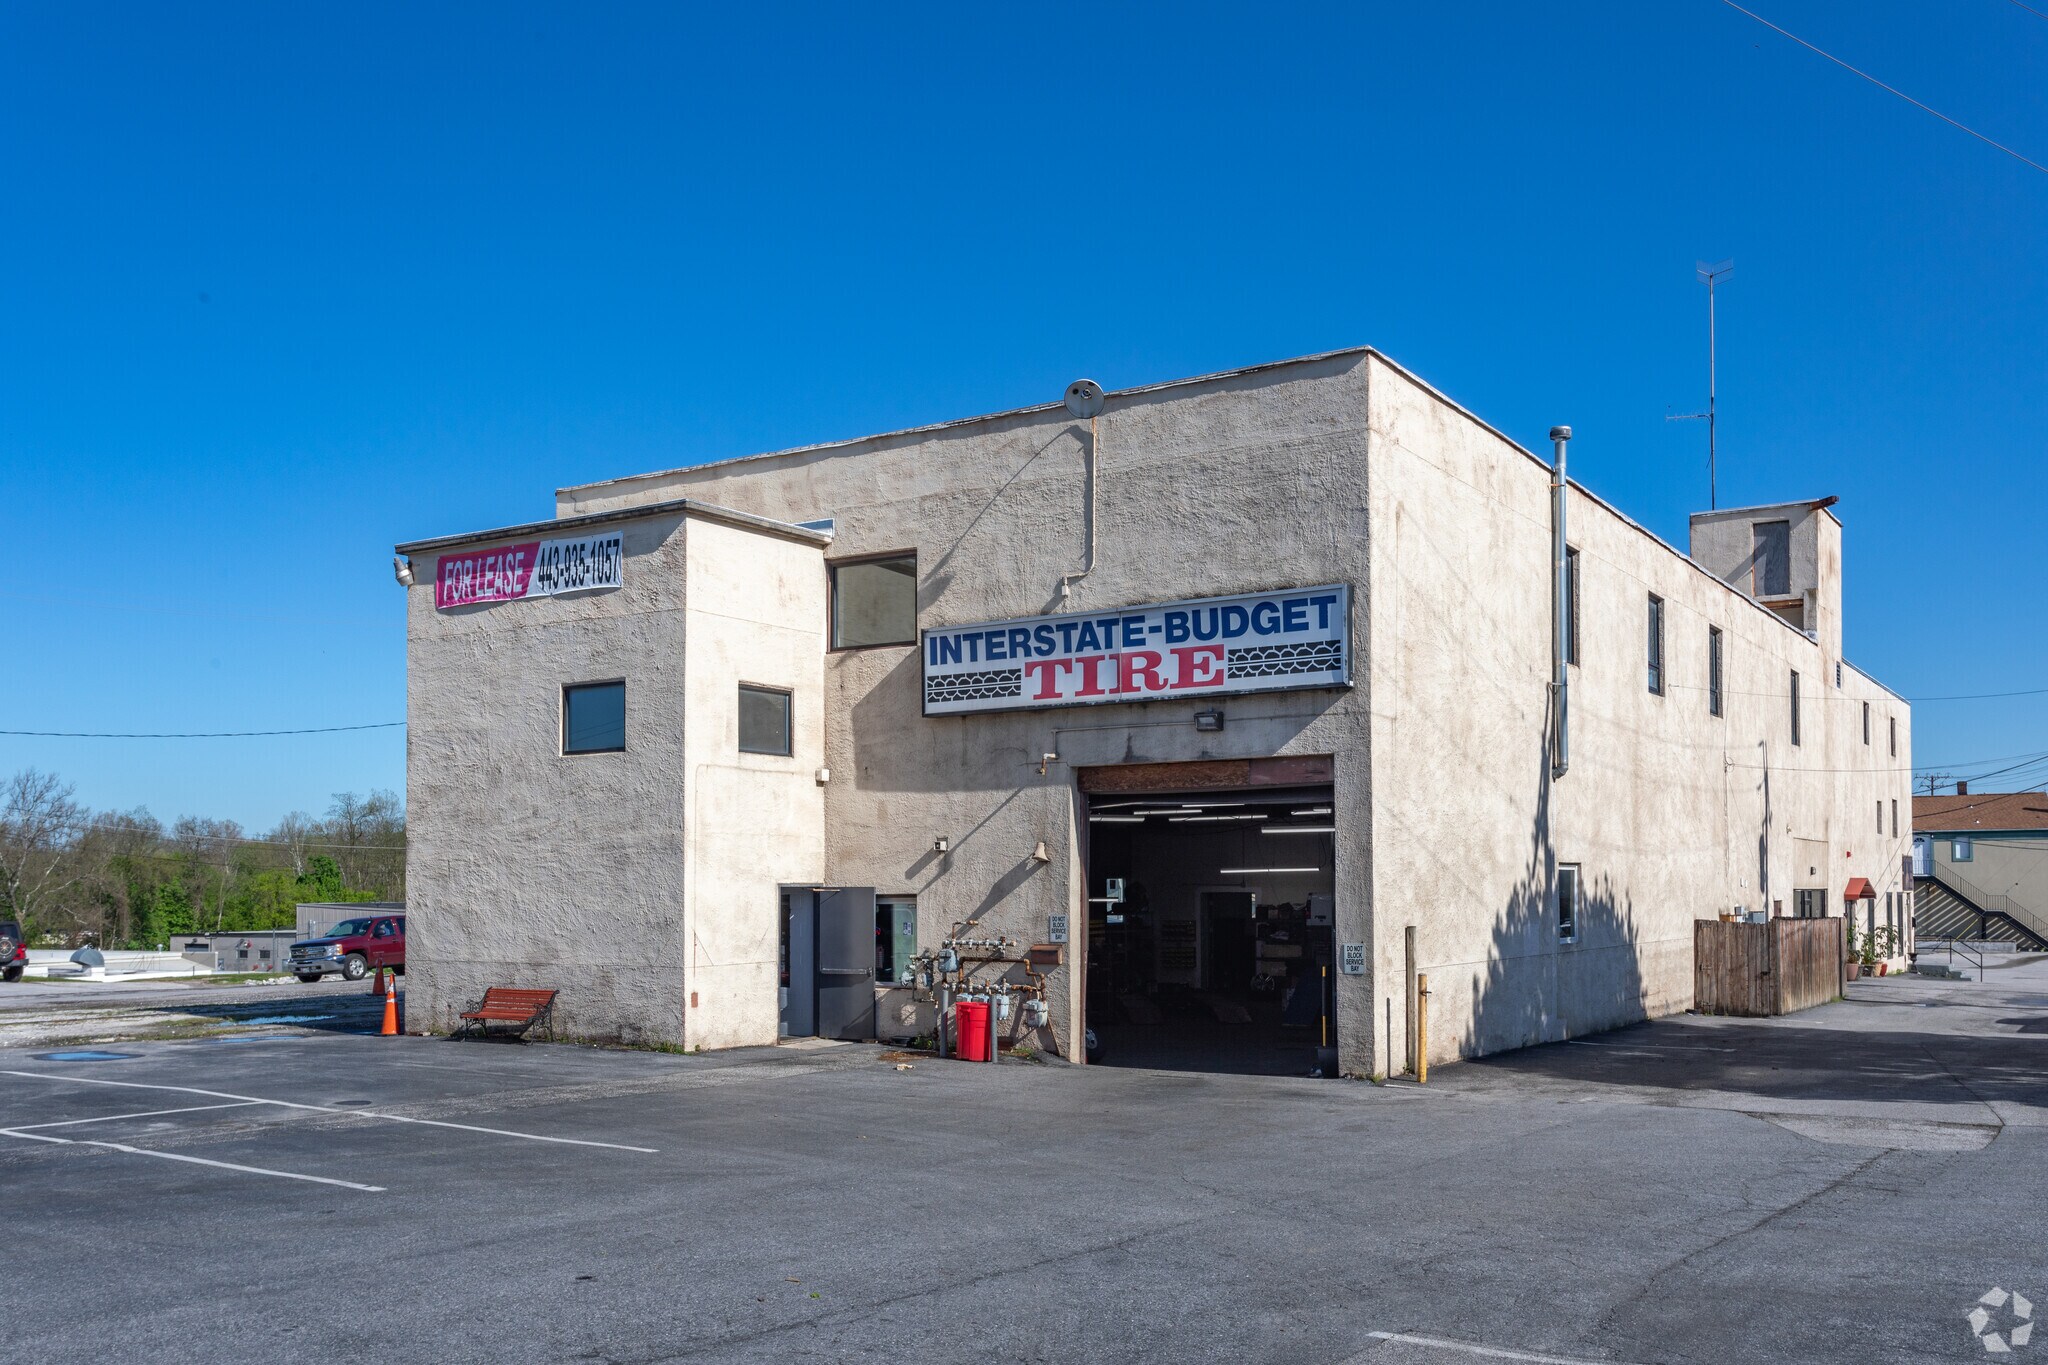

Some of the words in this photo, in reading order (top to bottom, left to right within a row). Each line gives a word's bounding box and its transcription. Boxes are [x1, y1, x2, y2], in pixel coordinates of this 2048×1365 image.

[443, 559, 474, 602] FOR
[476, 551, 525, 597] LEASE
[538, 538, 620, 591] 443-935-1057
[929, 594, 1337, 666] INTERSTATE-BUDGET
[1024, 643, 1225, 700] TIRE
